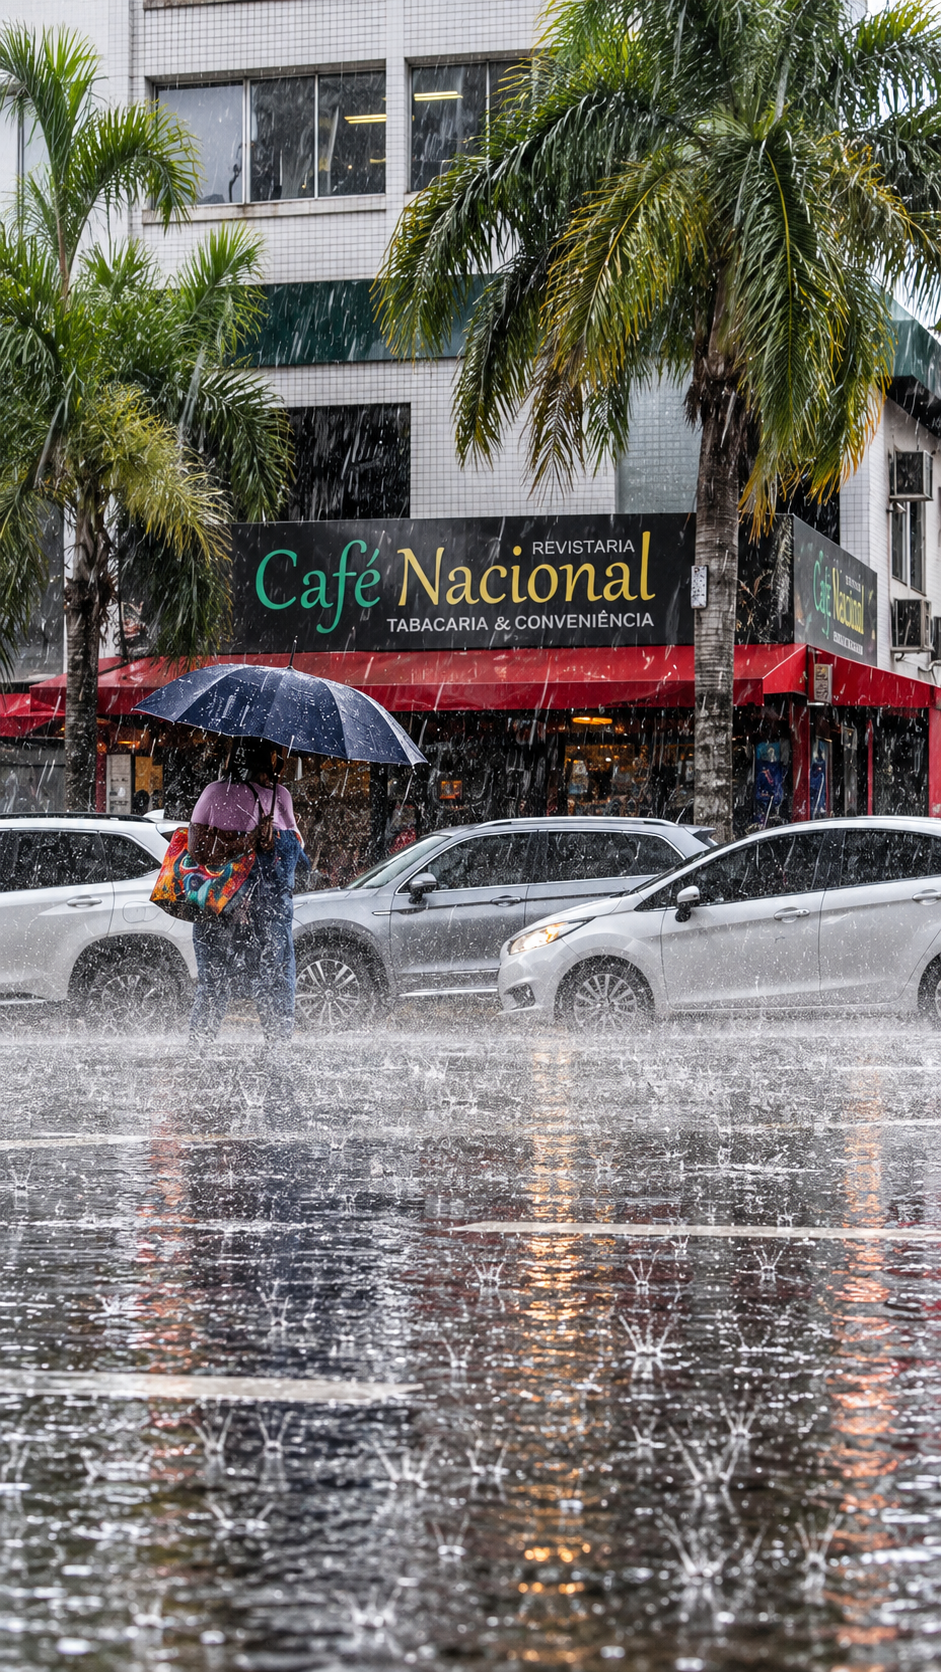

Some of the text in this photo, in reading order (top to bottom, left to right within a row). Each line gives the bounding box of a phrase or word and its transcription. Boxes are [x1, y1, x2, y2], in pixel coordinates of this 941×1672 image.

[532, 540, 635, 555] REVISTARIA
[255, 540, 380, 634] Café
[397, 531, 656, 606] Nacional
[387, 610, 655, 632] TABACARIA & CONVENIÊNCIA
